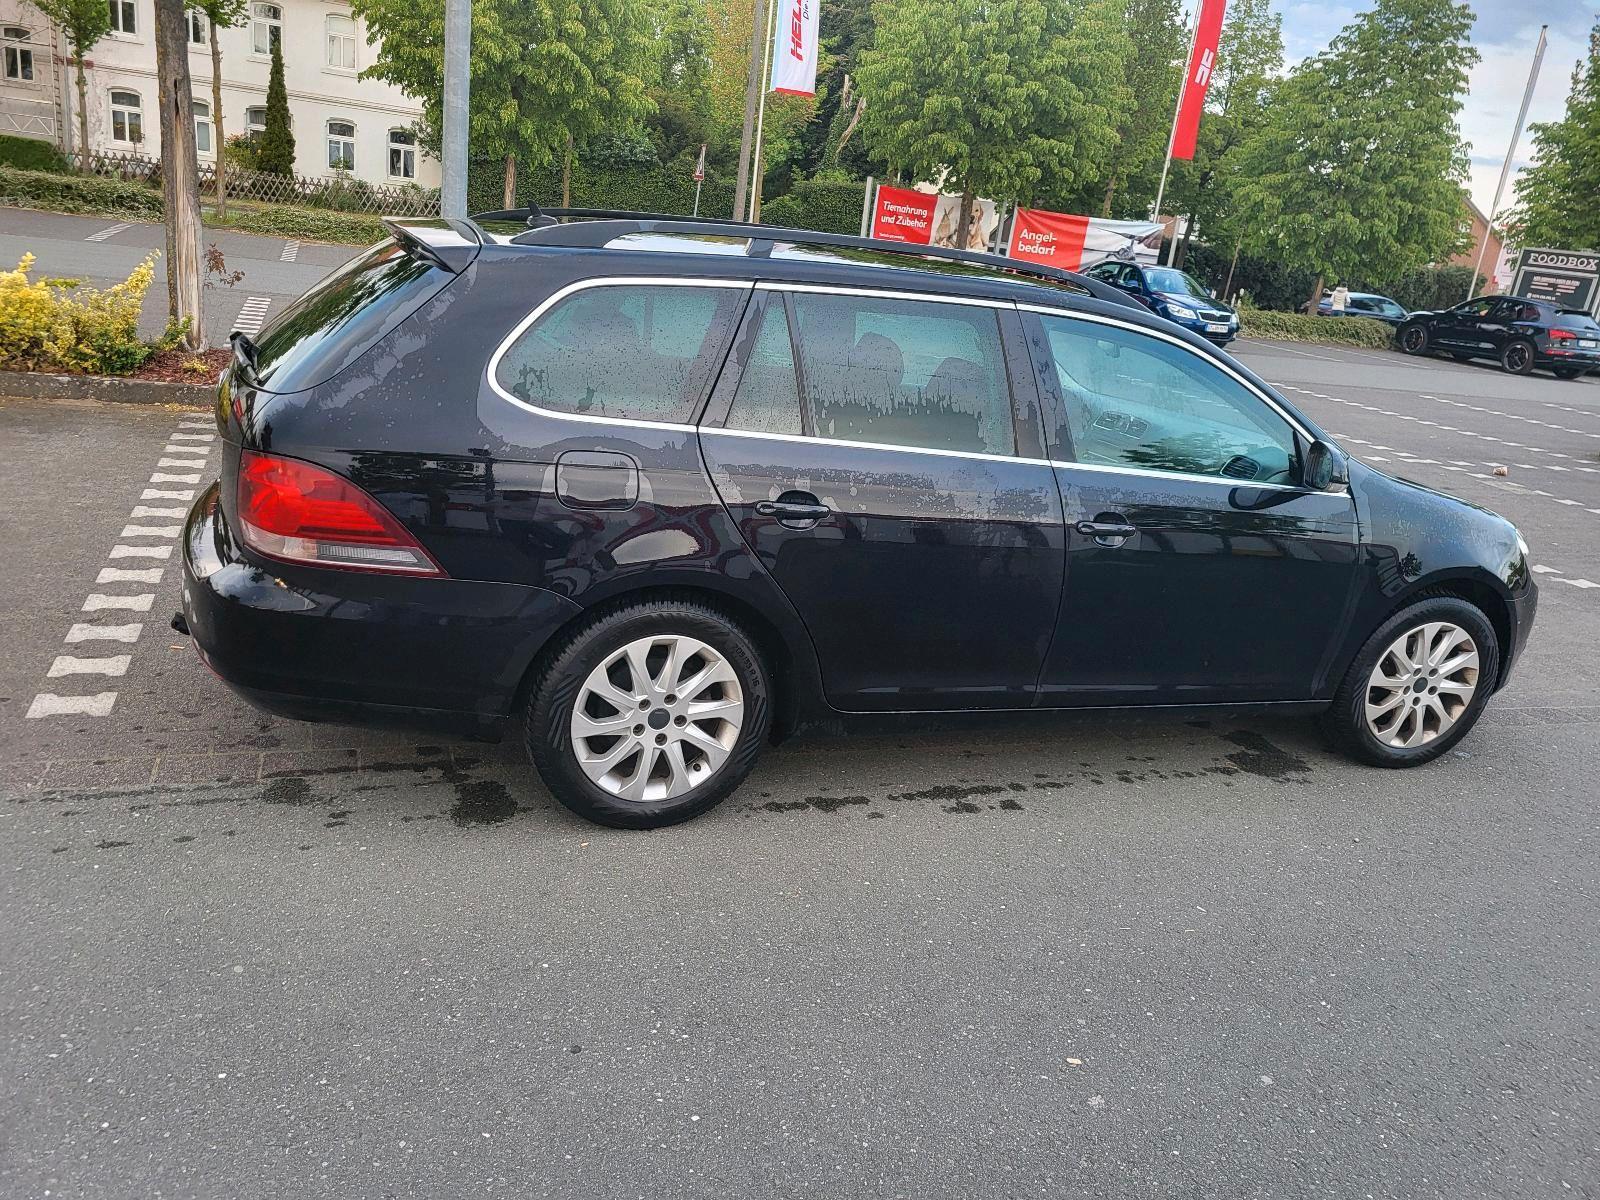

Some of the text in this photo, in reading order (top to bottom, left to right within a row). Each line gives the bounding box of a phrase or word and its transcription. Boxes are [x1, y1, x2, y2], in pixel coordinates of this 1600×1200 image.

[883, 200, 928, 218] Tiernahrung
[881, 214, 928, 229] und Zubehör
[1020, 228, 1057, 243] Angel-
[1018, 240, 1056, 256] bedarf
[1527, 252, 1600, 271] FOODBOX
